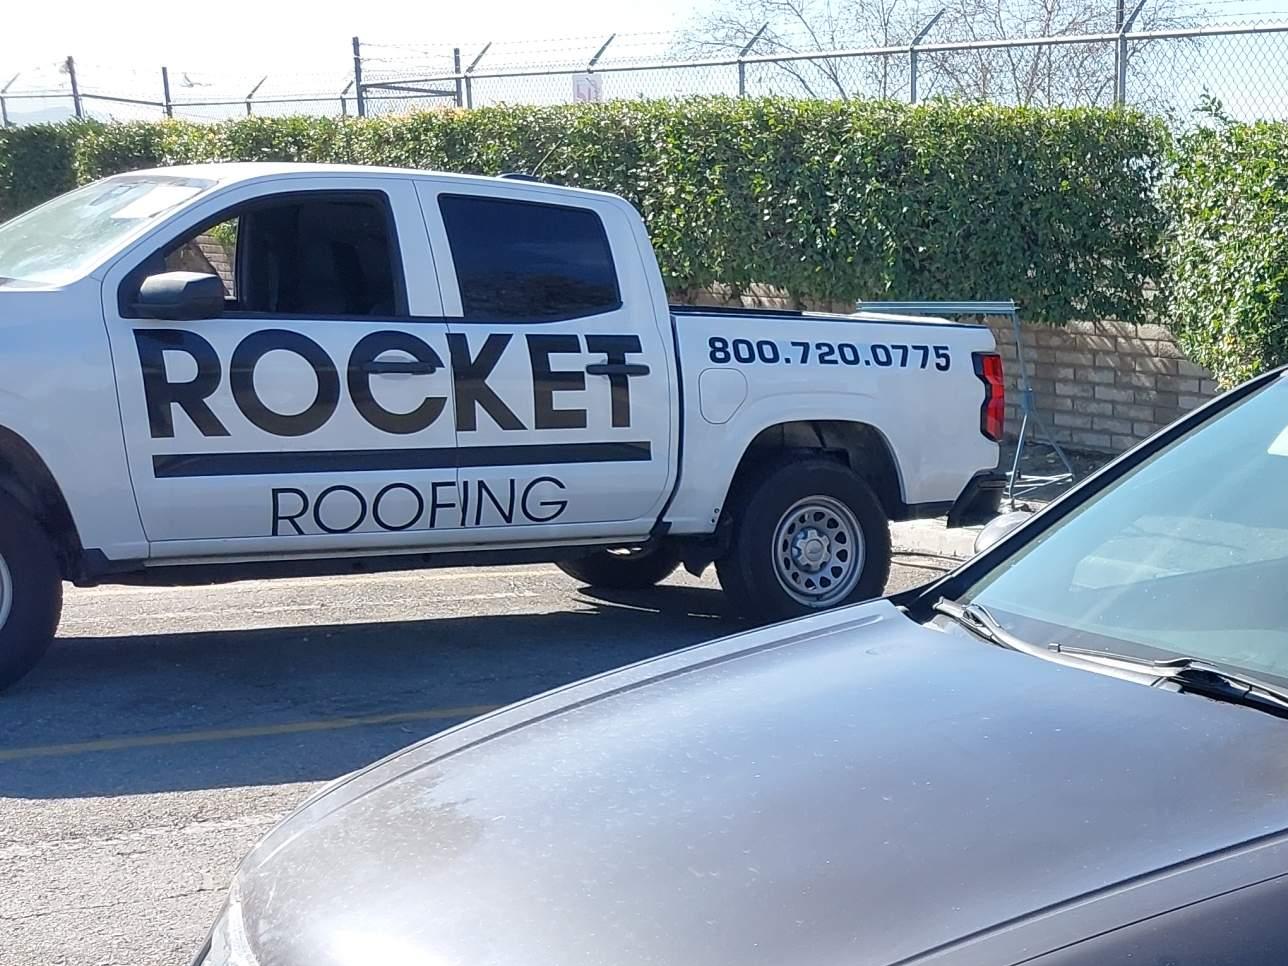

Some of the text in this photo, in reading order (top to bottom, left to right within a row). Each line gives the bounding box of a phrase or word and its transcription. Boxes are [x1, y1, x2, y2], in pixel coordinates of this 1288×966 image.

[133, 329, 645, 438] ROCKET
[709, 337, 951, 371] 800.720.0775
[271, 476, 568, 536] ROOFING
